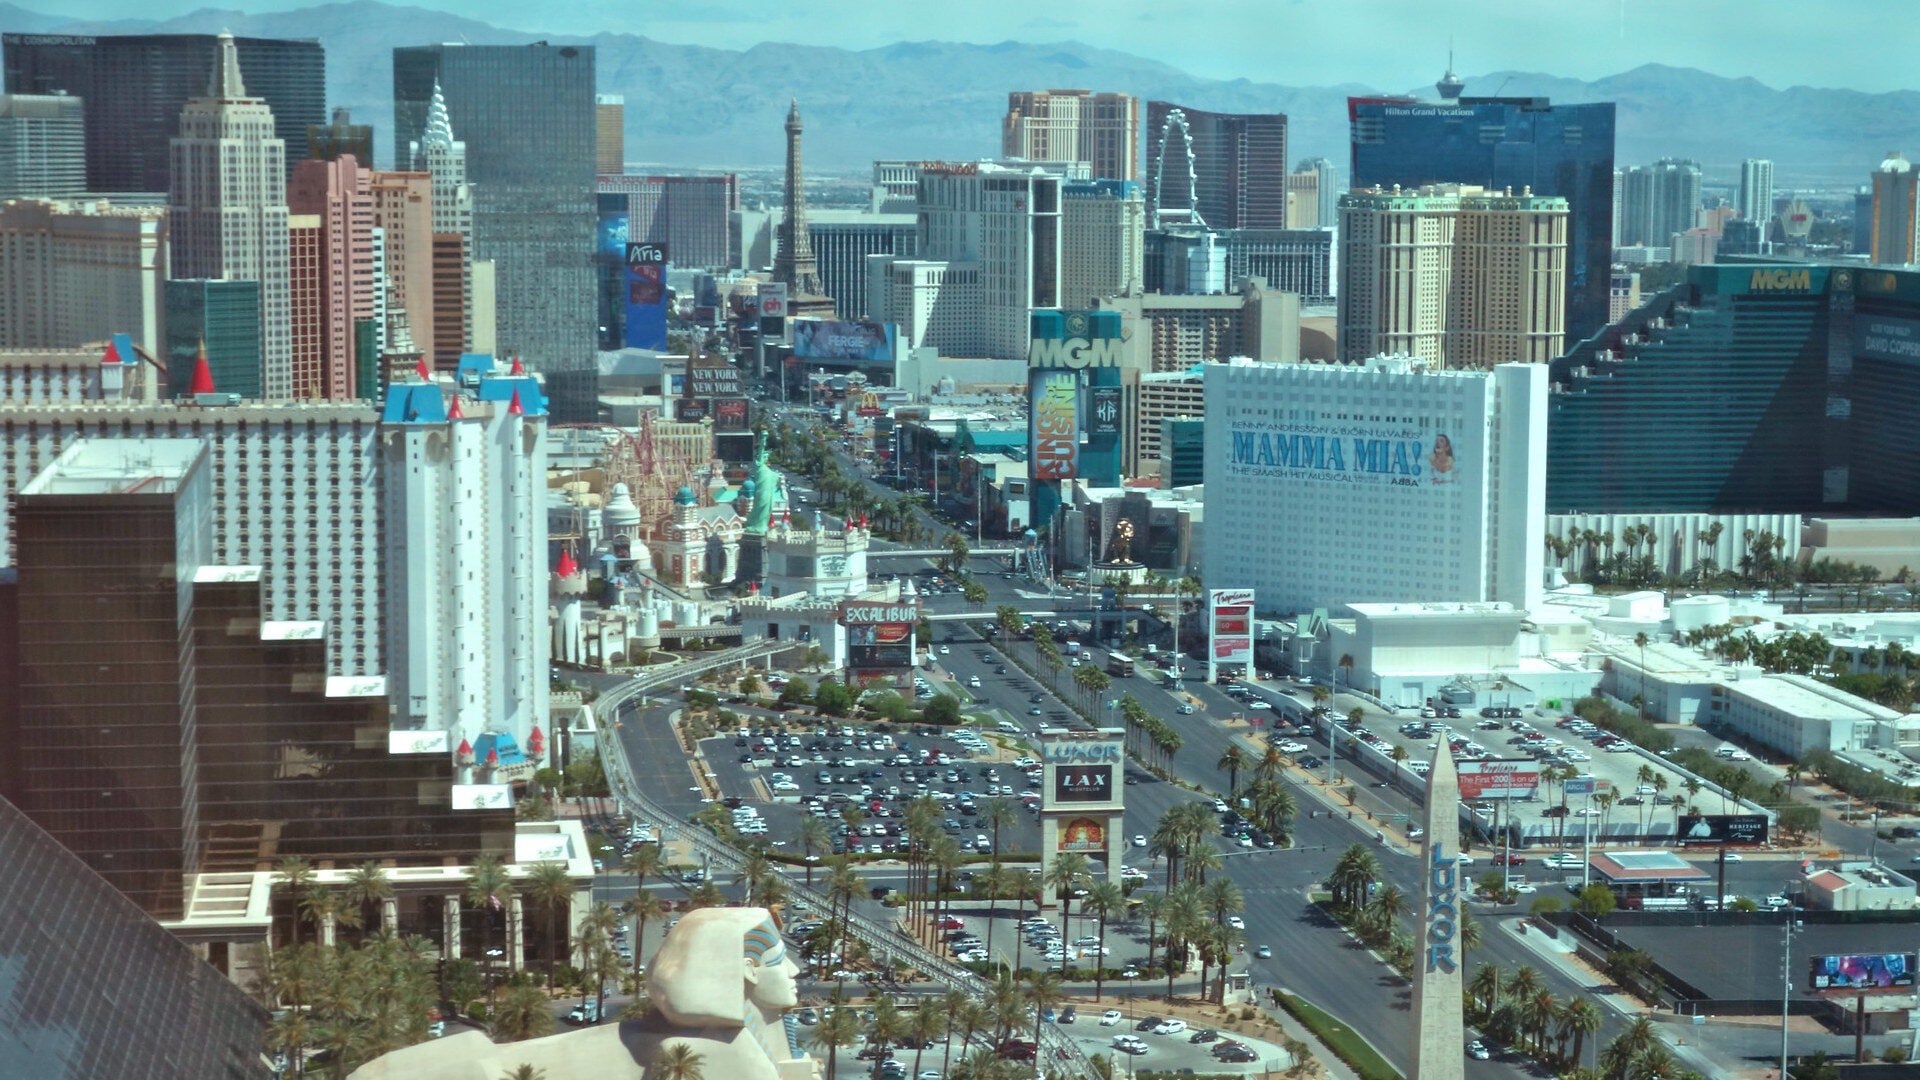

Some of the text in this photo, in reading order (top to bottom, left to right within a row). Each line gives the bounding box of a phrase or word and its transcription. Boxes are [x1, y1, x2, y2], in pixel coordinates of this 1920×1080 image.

[4, 35, 96, 46] THE COSMOPOLITAN
[1385, 107, 1475, 117] Hilton Grand Vacations
[630, 245, 663, 262] Aria
[1751, 269, 1811, 290] MGM
[1865, 336, 1888, 352] DAVID
[1030, 337, 1122, 369] MGM
[693, 369, 738, 380] NEW YORK
[693, 382, 738, 393] NEW YORK
[1055, 373, 1076, 479] CUISINE
[1231, 421, 1265, 430] BENNY
[1266, 423, 1328, 434] ANDERSSON
[1036, 398, 1057, 479] KINGS
[1231, 430, 1422, 477] MAMMA MIA!
[1231, 466, 1249, 476] THE
[1252, 468, 1288, 478] SMASH
[1290, 470, 1305, 479] HIT
[1308, 471, 1353, 483] MUSICAL
[846, 606, 917, 622] EXCALIBUR
[1044, 743, 1121, 758] LUXOR
[1062, 774, 1106, 786] LAX
[1459, 775, 1474, 784] The
[1567, 783, 1586, 791] ARCO
[1431, 842, 1459, 967] LUXOR
